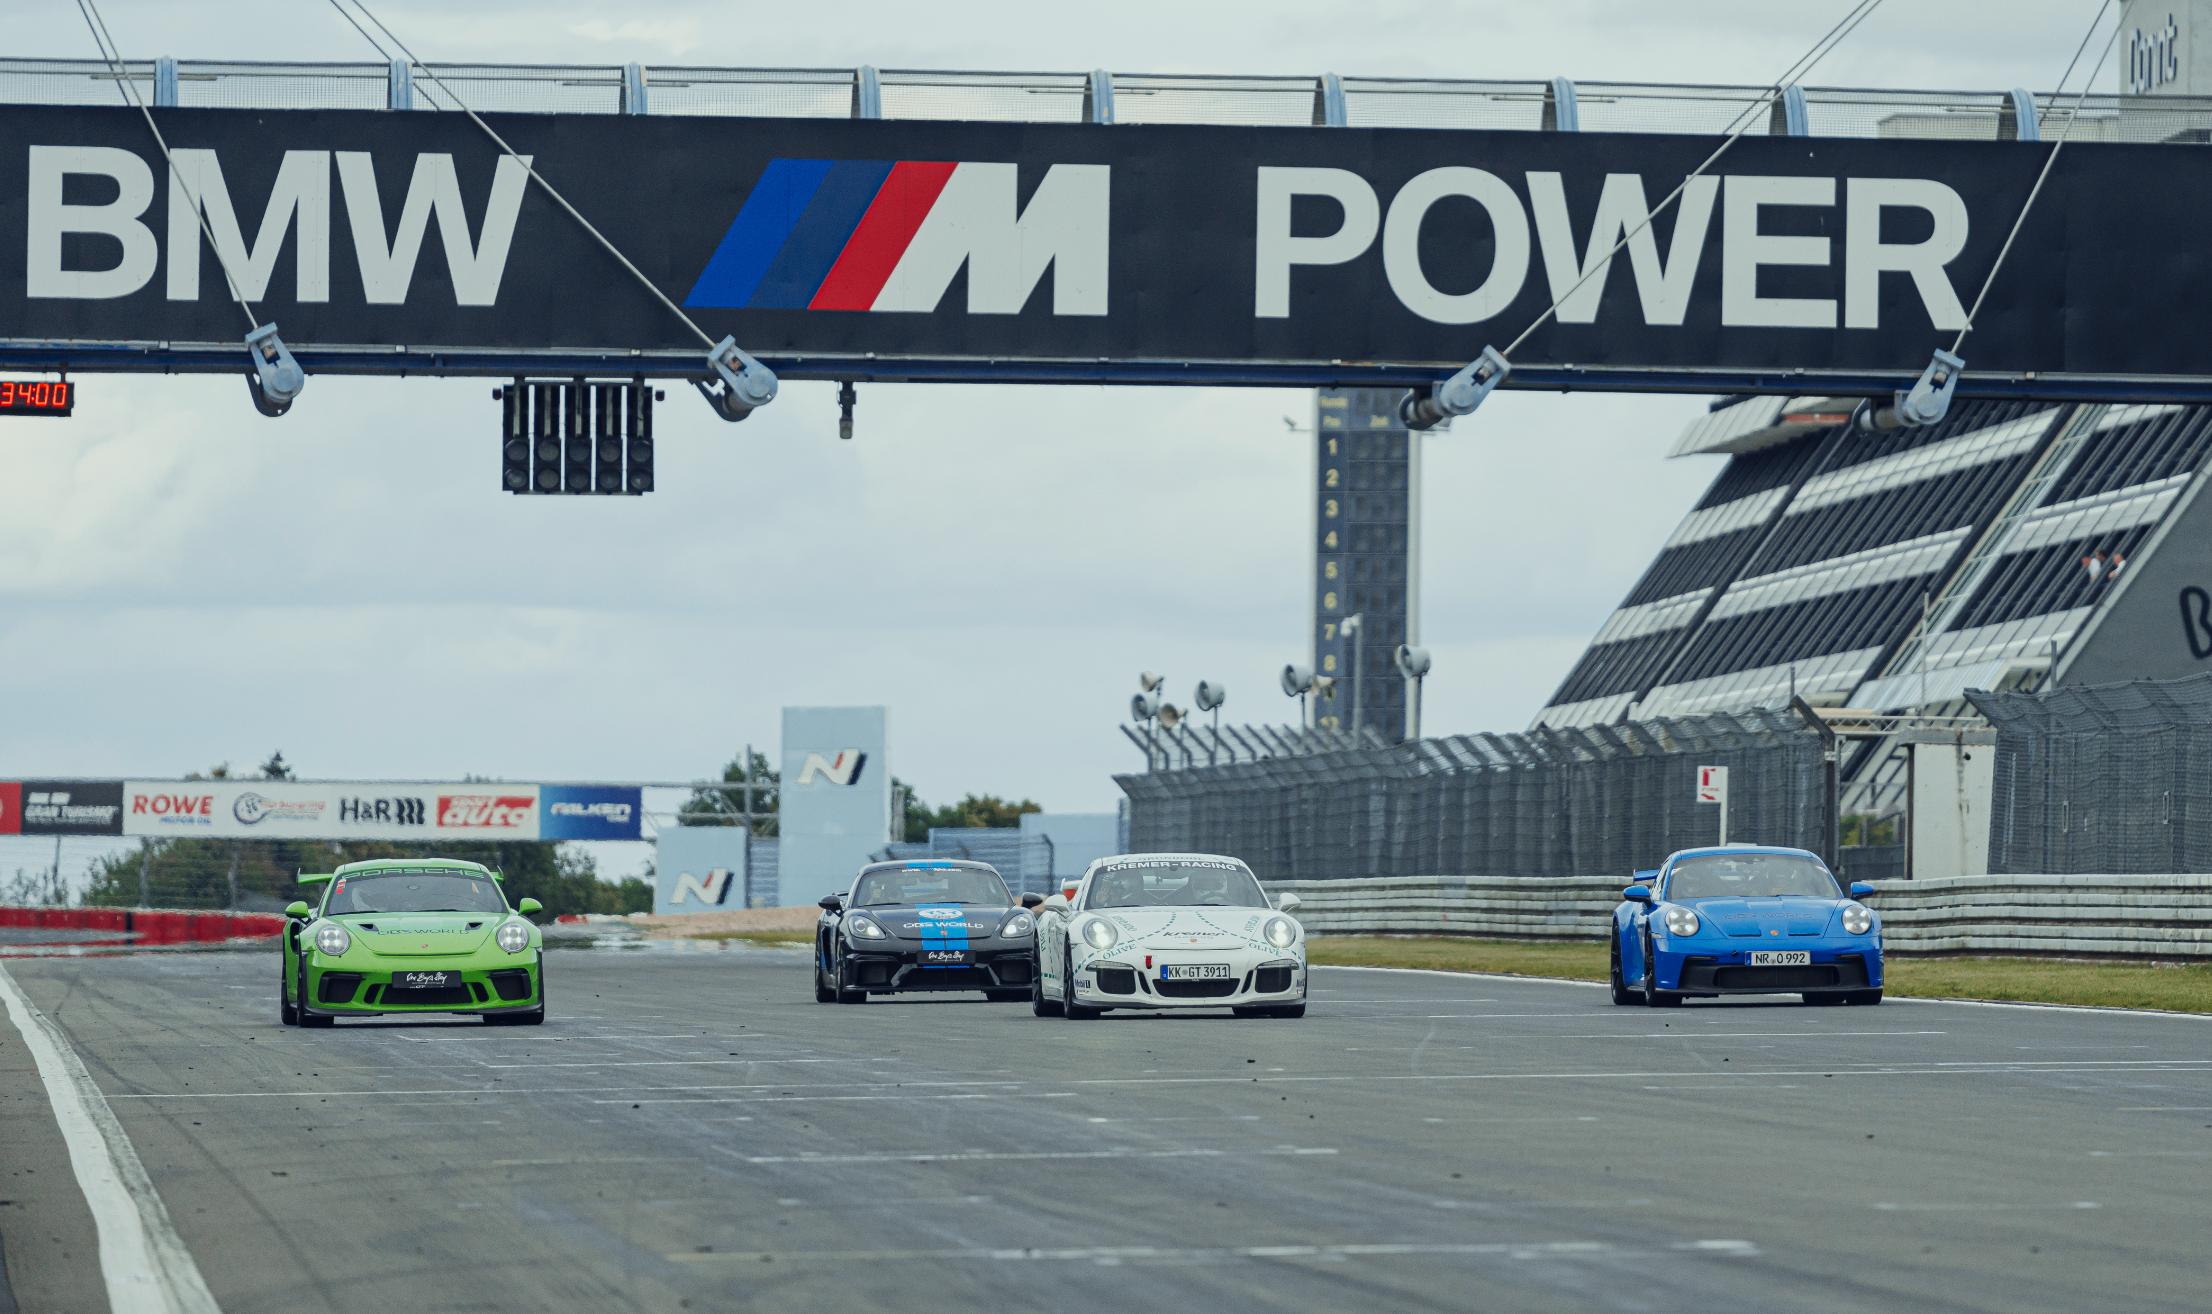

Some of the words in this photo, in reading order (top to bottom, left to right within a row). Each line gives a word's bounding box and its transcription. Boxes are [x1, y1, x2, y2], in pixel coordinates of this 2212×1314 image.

[27, 145, 533, 306] BMW
[869, 161, 1111, 316] M
[1255, 166, 1973, 331] POWER
[1326, 438, 1338, 456] 1
[1325, 469, 1339, 488] 2
[1325, 499, 1339, 519] 3
[1324, 530, 1339, 549] 4
[1324, 561, 1338, 580] 5
[1323, 592, 1338, 611] 6
[1323, 624, 1338, 642] 7
[132, 794, 214, 816] ROWE
[339, 797, 391, 821] H&R
[443, 804, 531, 824] auto
[341, 867, 485, 879] PORSCHE
[1103, 943, 1137, 959] OLIVE
[1248, 942, 1282, 957] OLIVE
[1755, 953, 1769, 964] NR
[1786, 953, 1806, 964] 992
[1168, 966, 1181, 978] KK
[1188, 966, 1201, 978] GT
[1203, 966, 1228, 978] 3911
